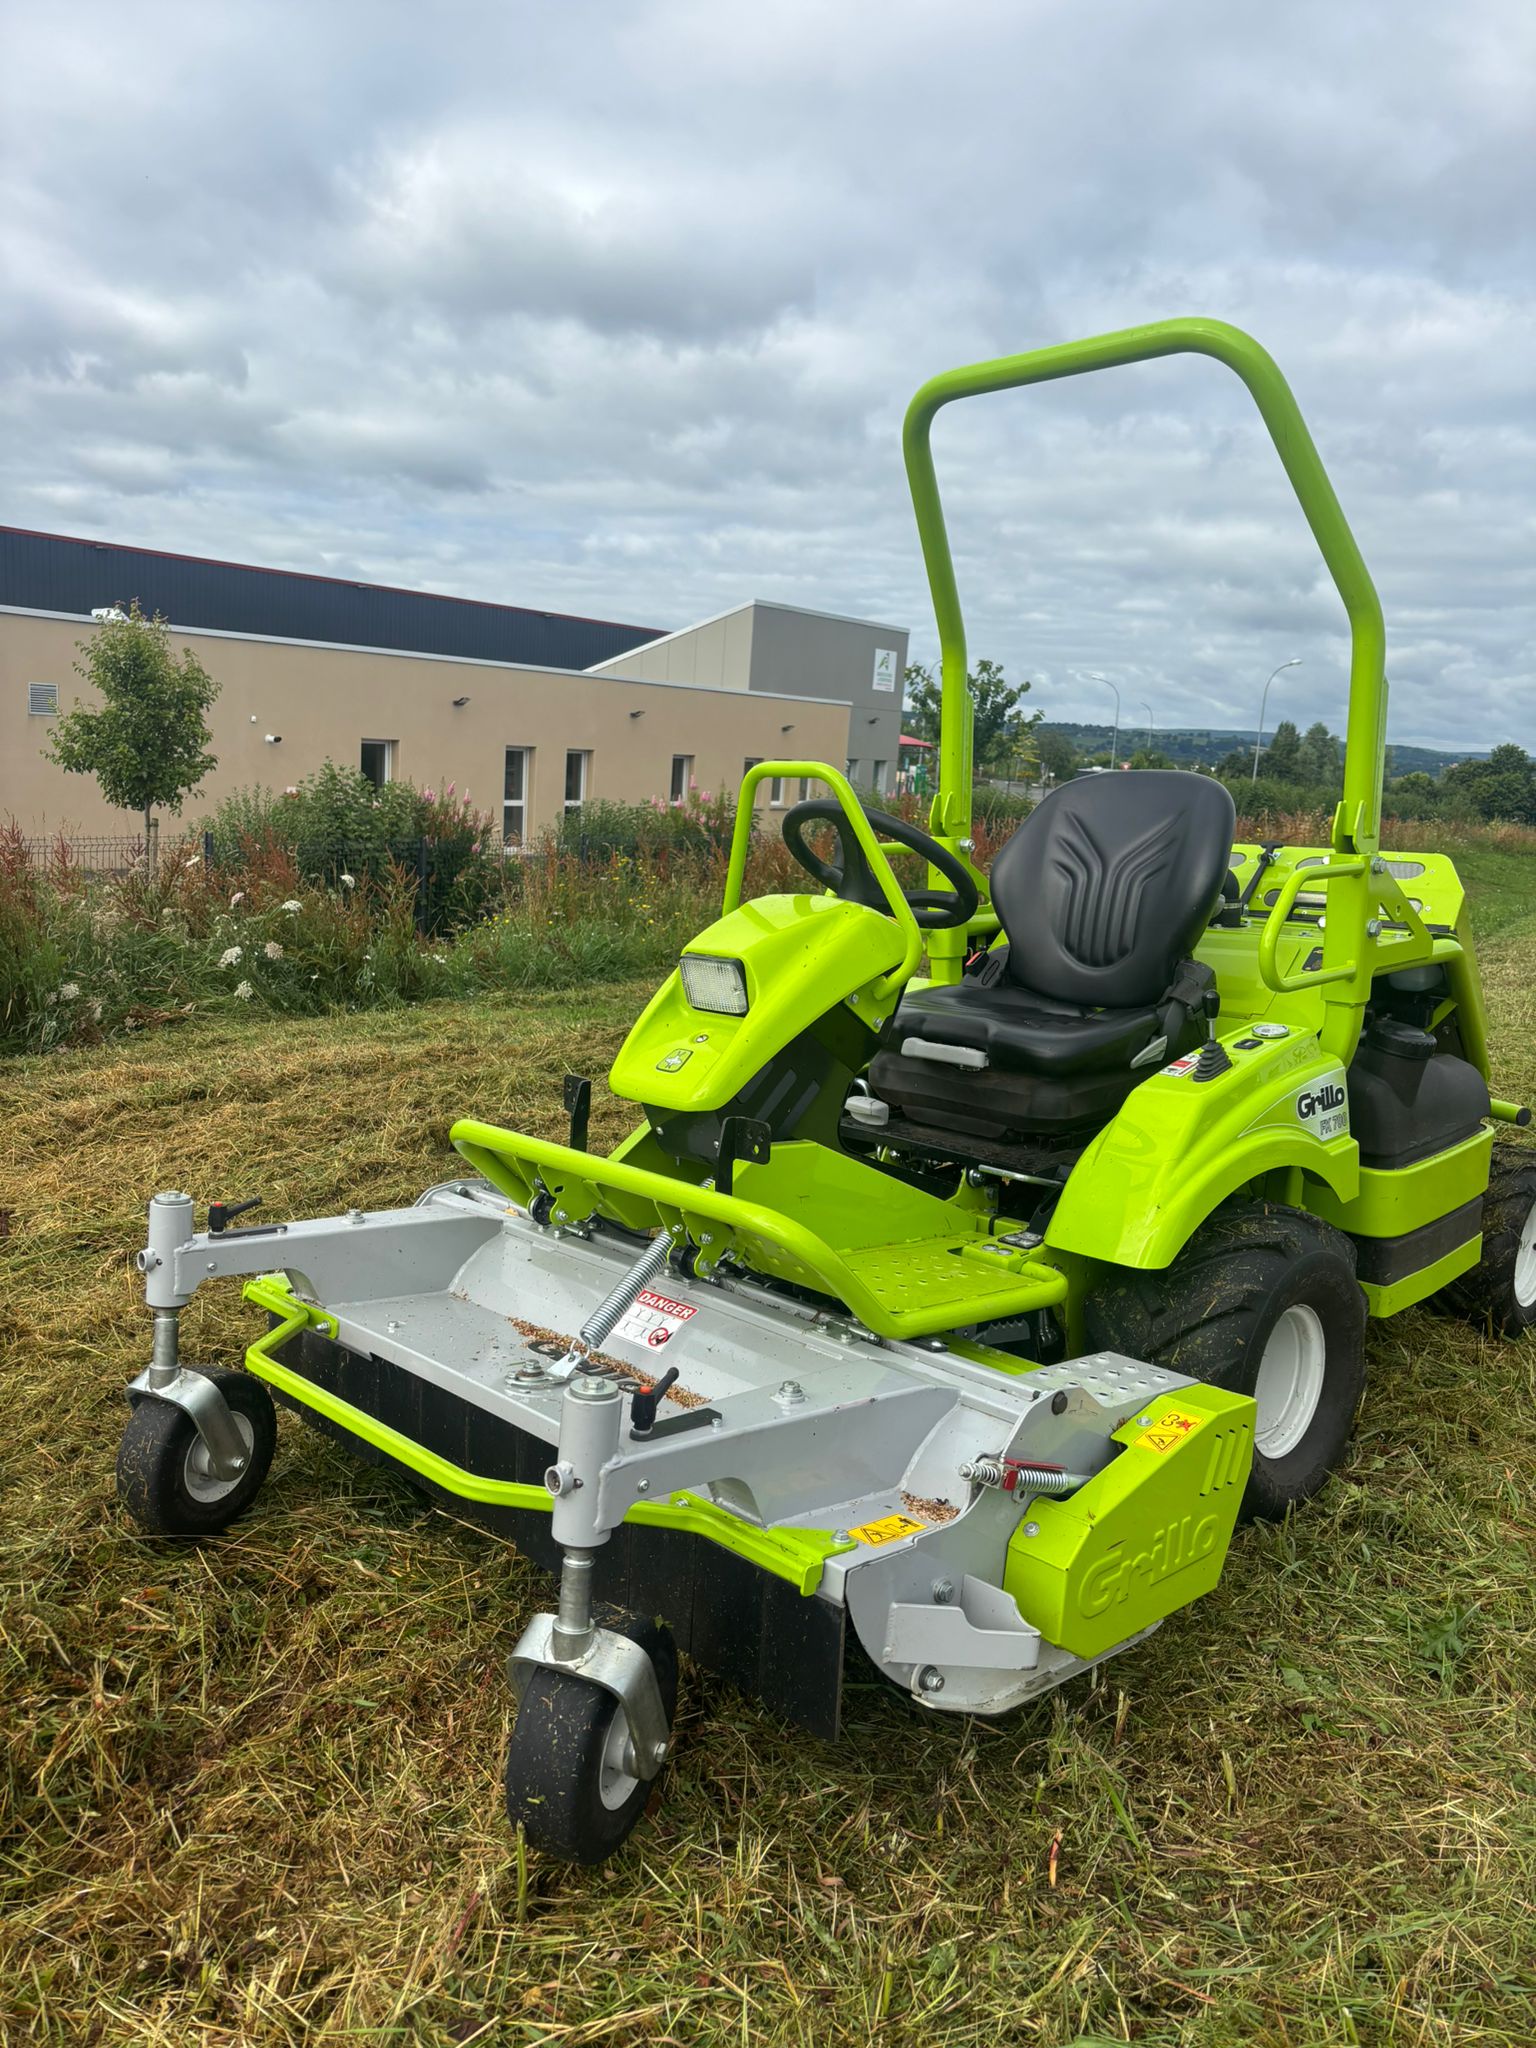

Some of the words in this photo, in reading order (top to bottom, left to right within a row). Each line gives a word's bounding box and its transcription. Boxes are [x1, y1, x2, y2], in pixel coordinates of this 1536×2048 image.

[1297, 1084, 1345, 1120] Grillo
[638, 1292, 694, 1319] DANGER
[1078, 1514, 1219, 1620] Grillo
